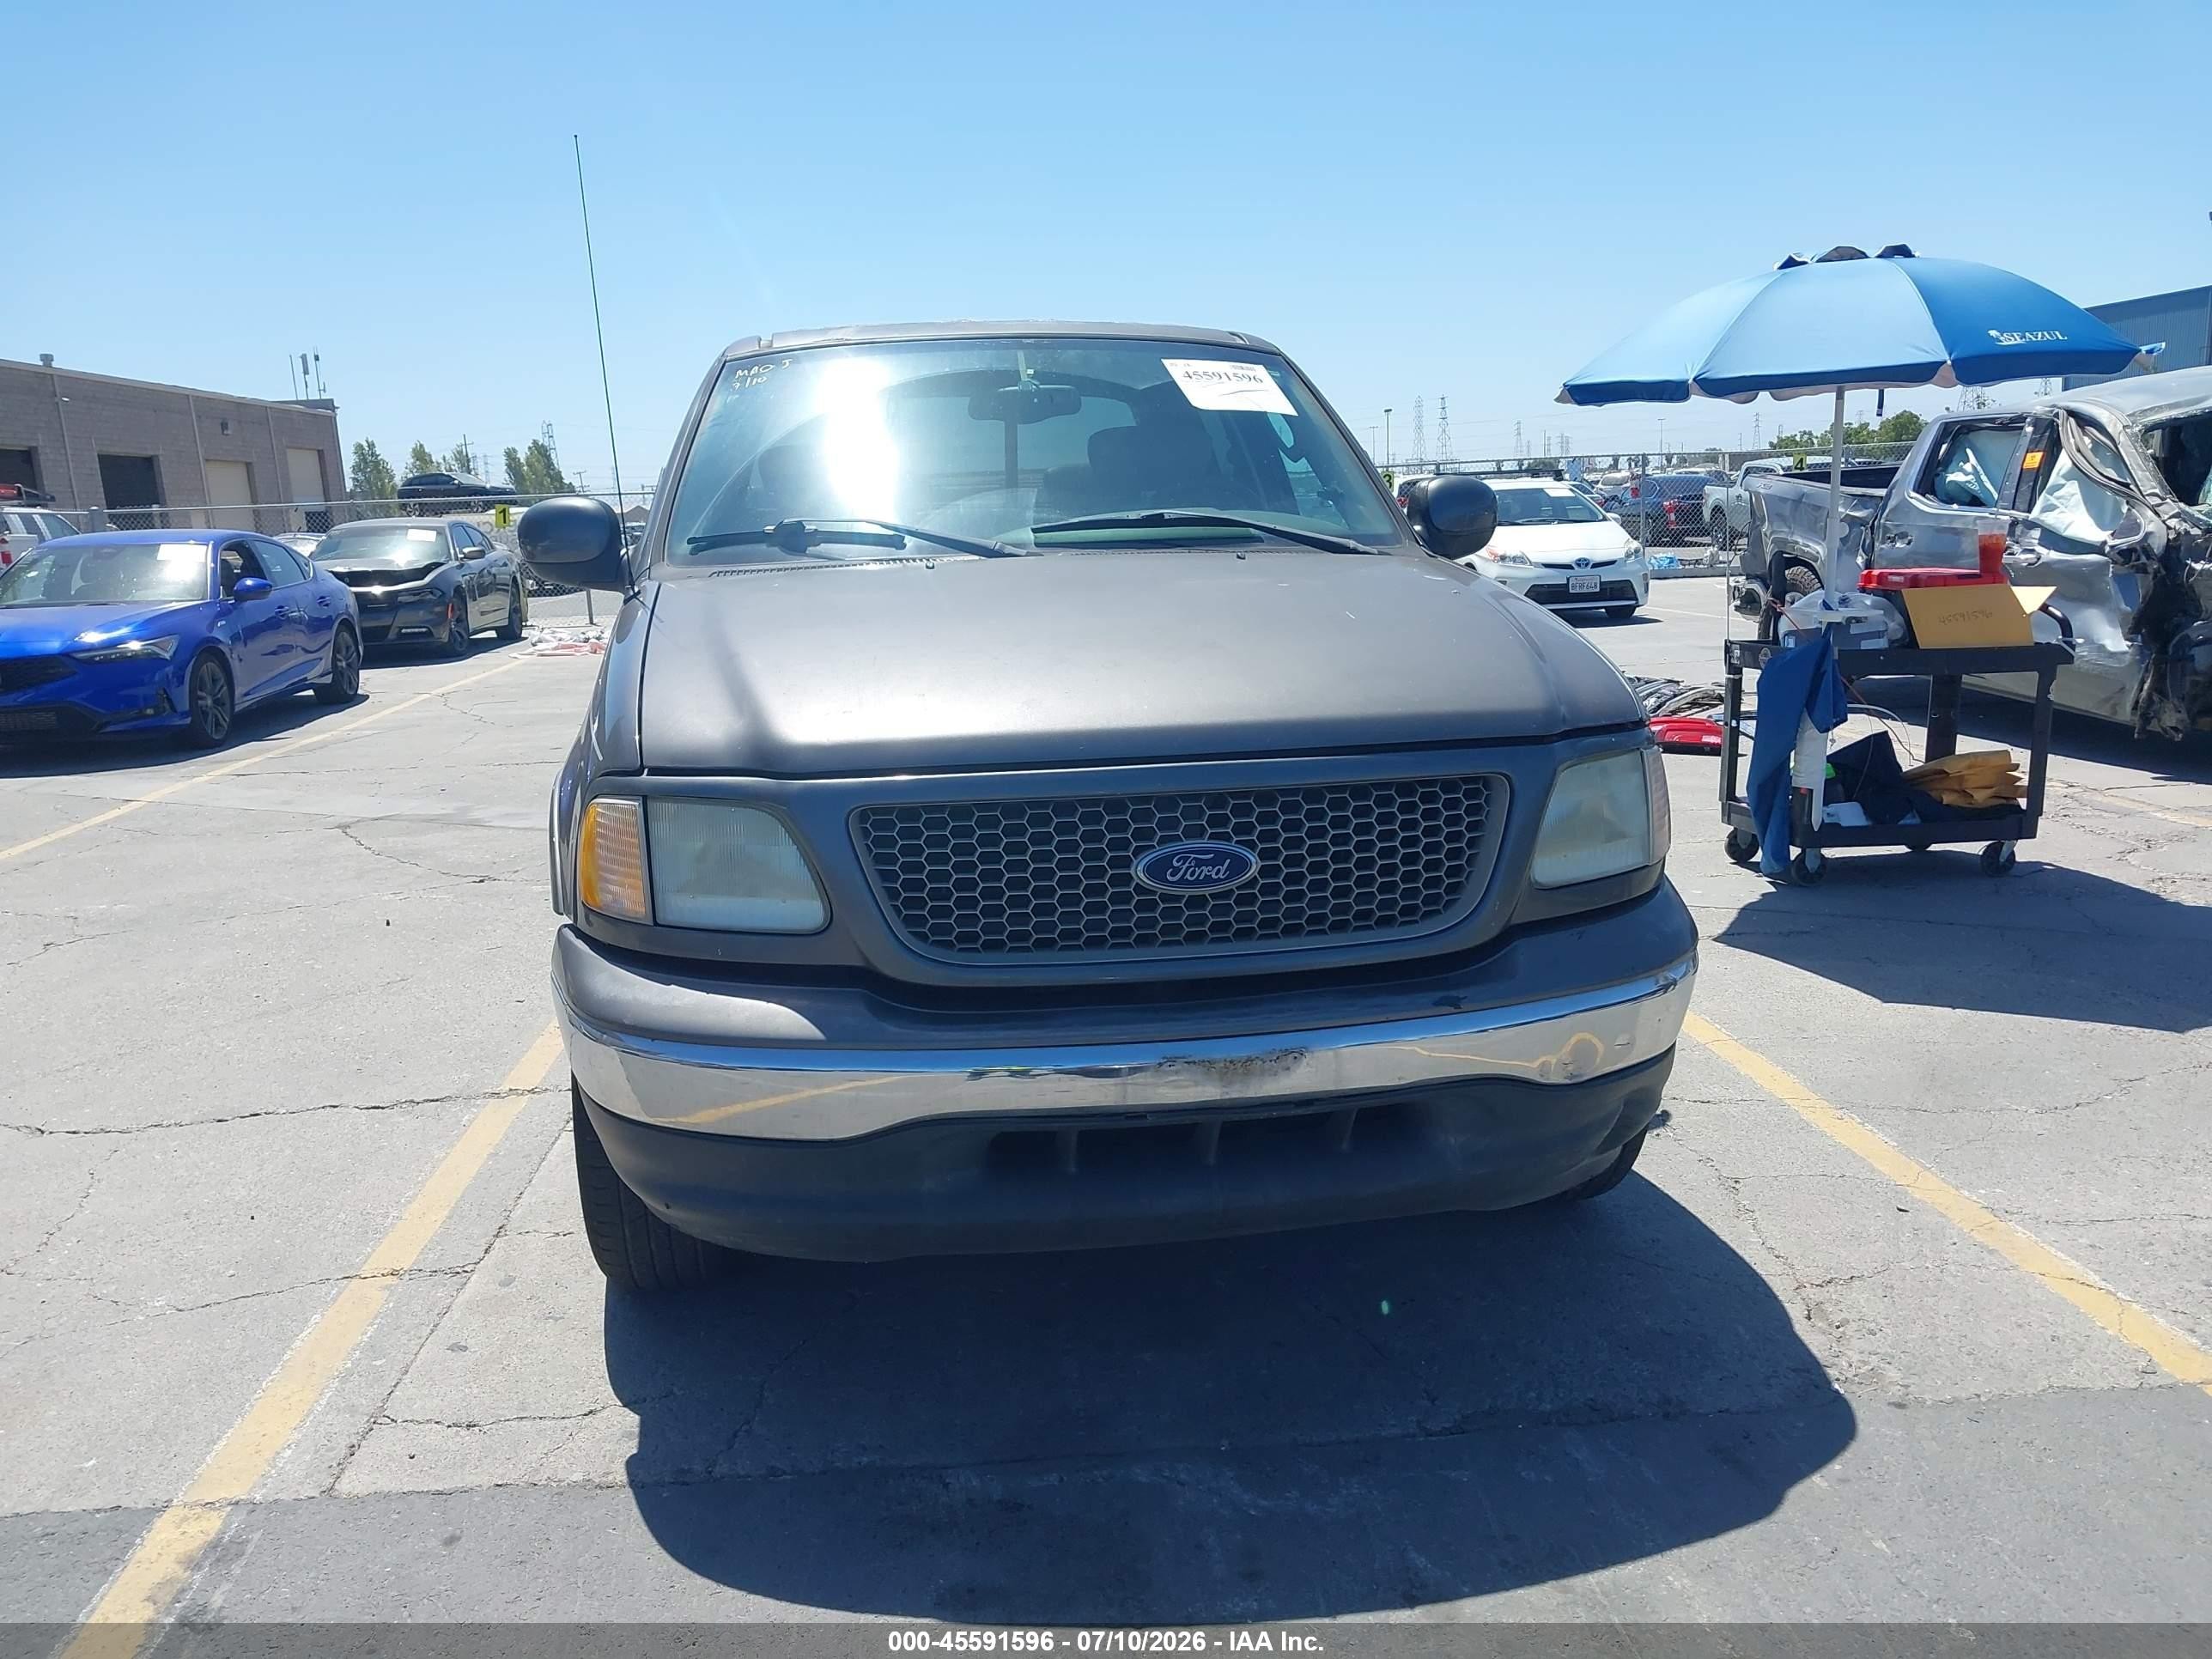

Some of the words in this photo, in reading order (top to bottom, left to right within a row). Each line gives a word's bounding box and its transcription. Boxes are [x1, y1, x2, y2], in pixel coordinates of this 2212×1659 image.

[2003, 331, 2068, 342] SEAZUL
[1182, 370, 1264, 384] 45591596
[1794, 457, 1805, 471] 4
[1382, 473, 1392, 489] 3
[498, 507, 507, 524] 1
[1166, 854, 1231, 881] Ford
